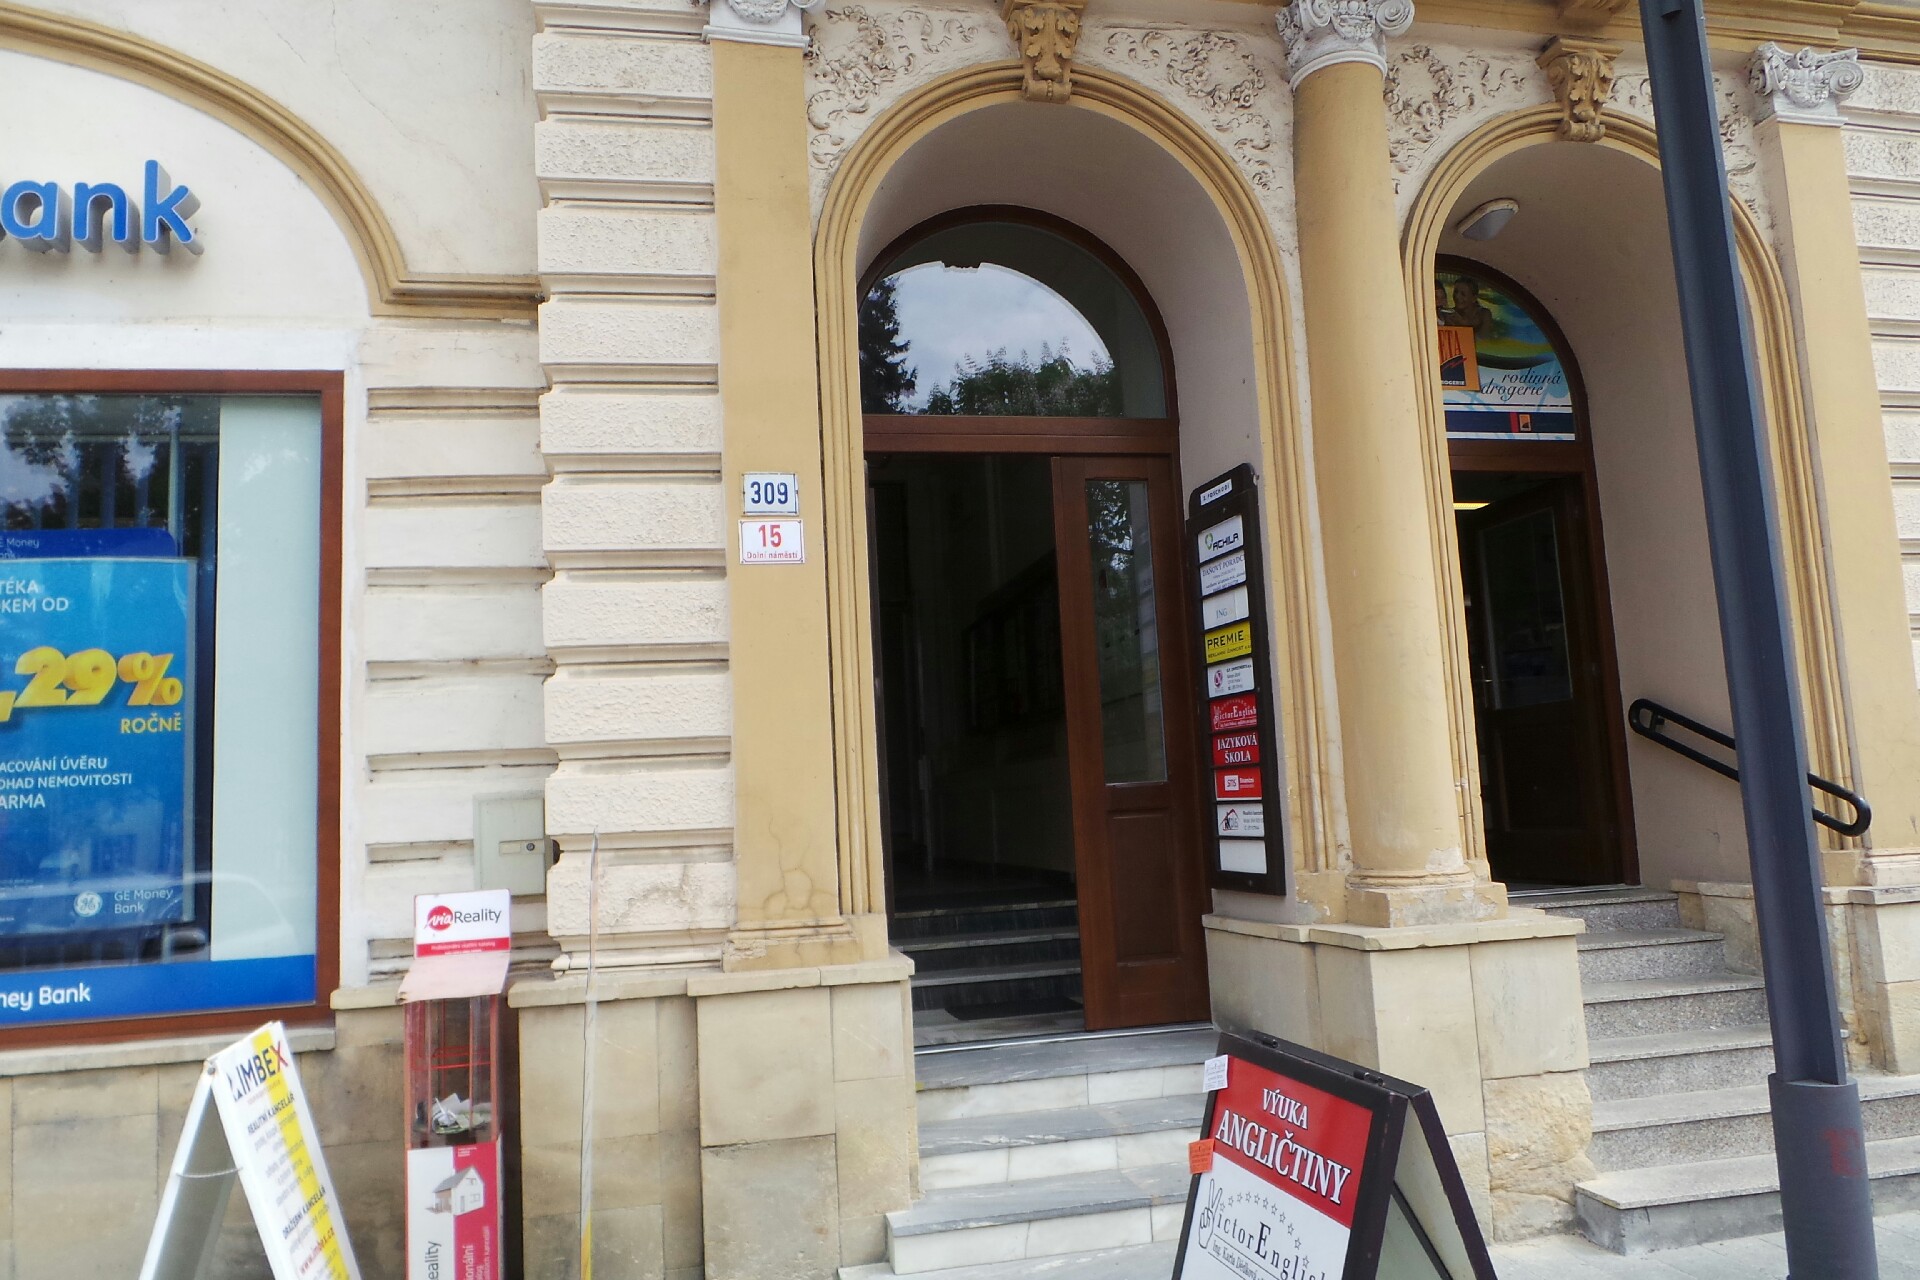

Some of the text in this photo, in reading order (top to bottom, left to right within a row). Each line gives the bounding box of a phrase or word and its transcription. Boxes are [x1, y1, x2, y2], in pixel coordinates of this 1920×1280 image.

[0, 160, 194, 243] ank
[1502, 368, 1561, 384] rodinná
[1480, 378, 1544, 401] drogerie
[751, 482, 788, 504] 309
[6, 537, 40, 549] Money
[759, 525, 782, 547] 15
[769, 551, 798, 559] náměstí
[0, 597, 69, 614] KEM OD
[1207, 630, 1244, 649] PREMIE
[121, 712, 182, 734] ROČNĚ
[1217, 733, 1258, 750] JAZYKOVÁ
[60, 755, 108, 771] ÚVĚRU
[1224, 750, 1251, 763] ŠKOLA
[37, 773, 132, 788] NEMOVITOSTI
[114, 889, 174, 901] GE Money
[114, 902, 145, 914] Bank
[39, 982, 91, 1005] Bank
[226, 1040, 289, 1102] LIMBEX
[1262, 1088, 1309, 1130] VÝUKA
[1215, 1109, 1351, 1205] ANGLIČTINY
[425, 1240, 442, 1280] eality
